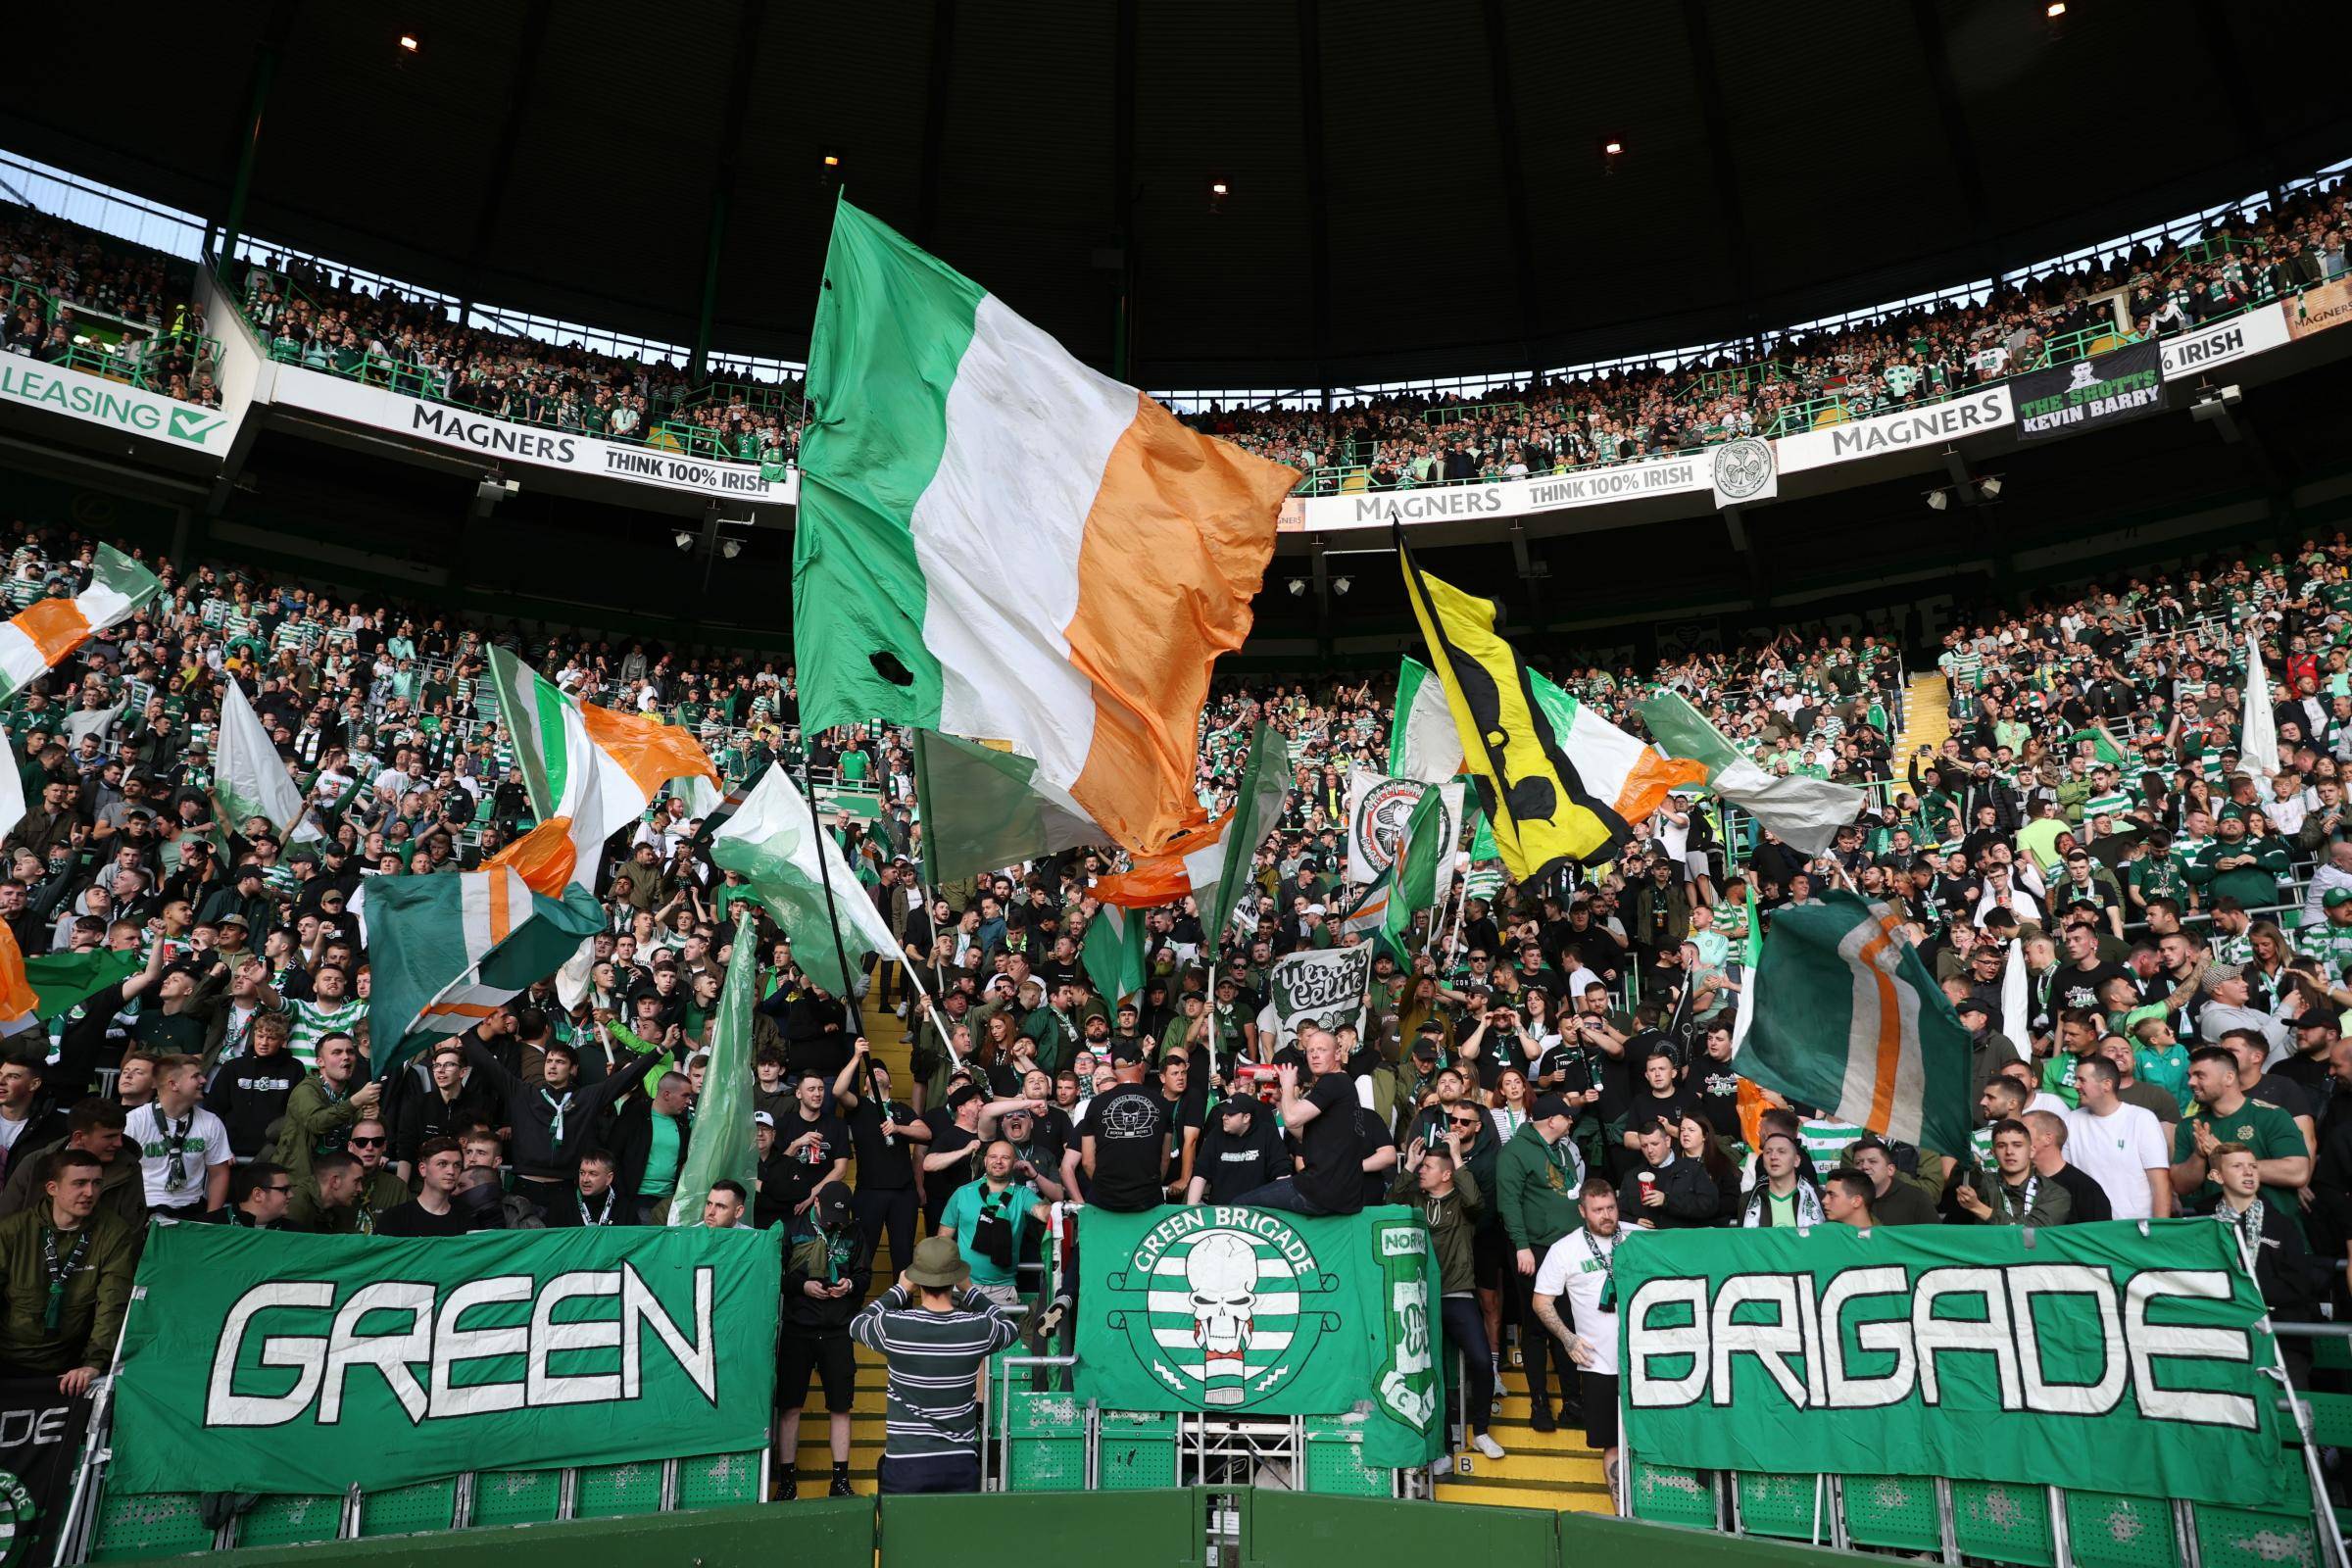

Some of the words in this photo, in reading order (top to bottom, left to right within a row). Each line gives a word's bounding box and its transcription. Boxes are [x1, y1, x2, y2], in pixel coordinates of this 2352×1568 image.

[2179, 328, 2244, 367] IRISH
[1, 366, 161, 430] LEASING
[2020, 394, 2064, 418] THE
[2068, 368, 2157, 405] SHOTTS
[2023, 405, 2084, 432] KEVIN
[2089, 384, 2159, 417] BARRY
[412, 403, 576, 465] MAGNERS
[1832, 394, 2003, 457] MAGNERS
[606, 451, 662, 477] THINK
[667, 462, 717, 487] 100%
[721, 470, 770, 493] IRISH
[1530, 481, 1586, 504] THINK
[1589, 473, 1640, 495] 100%
[1643, 466, 1693, 488] IRISH
[1277, 515, 1301, 524] GNERS
[1356, 488, 1501, 521] MAGNERS
[1364, 782, 1398, 810] GREEN
[1275, 948, 1367, 990] Ultras
[1289, 971, 1364, 1010] Celtic
[1134, 1210, 1205, 1273] GREEN
[1214, 1206, 1316, 1275] BRIGADE
[204, 1257, 718, 1429] GREEN
[1627, 1262, 2261, 1434] BRIGADE
[1460, 1457, 1472, 1472] B
